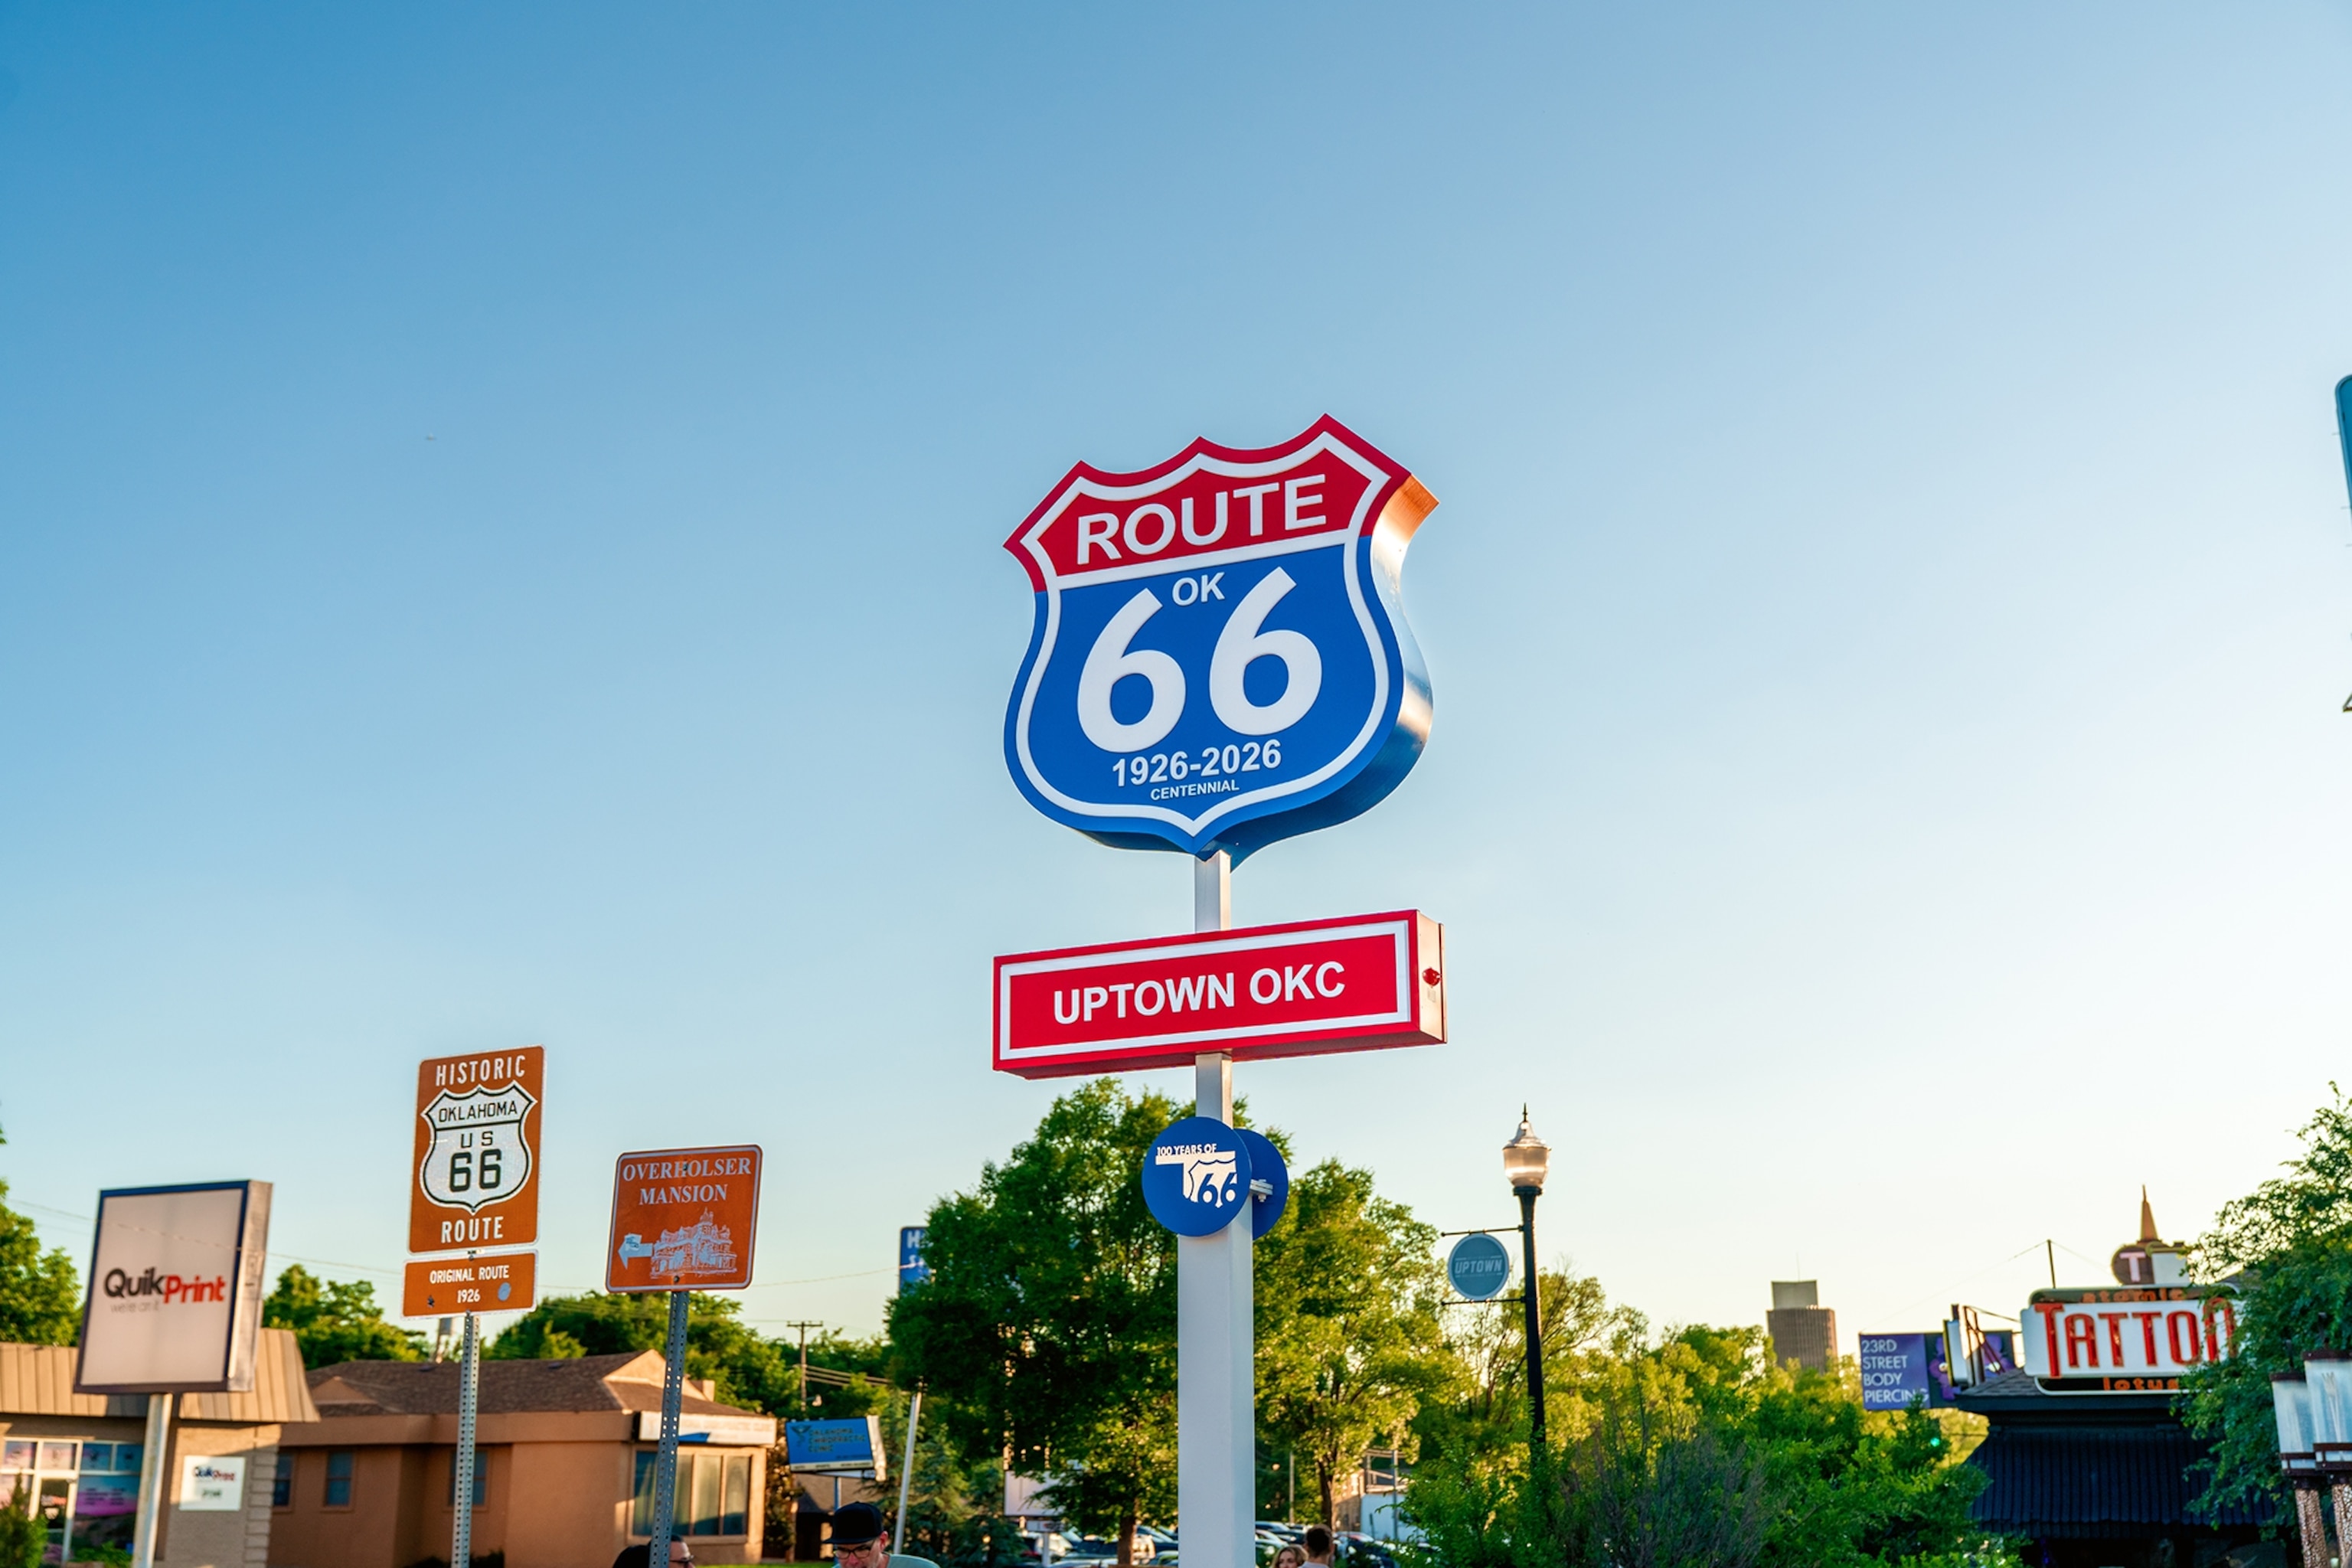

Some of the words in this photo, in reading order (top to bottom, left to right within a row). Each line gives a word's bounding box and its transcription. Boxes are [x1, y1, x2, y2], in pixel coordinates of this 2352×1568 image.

[1076, 474, 1326, 565] ROUTE
[1171, 572, 1225, 606] OK
[1076, 567, 1322, 753] 66
[1112, 739, 1282, 787] 1926-2026
[1150, 779, 1240, 801] CENTENNIAL
[1054, 972, 1234, 1024] UPTOWN
[1250, 961, 1345, 1004] OKC
[435, 1055, 526, 1086] HISTORIC
[439, 1100, 518, 1123] OKLAHOMA
[1157, 1146, 1173, 1156] 100
[1174, 1144, 1203, 1155] YEARS
[1204, 1143, 1217, 1154] OF
[449, 1148, 501, 1192] 66
[622, 1158, 751, 1181] OVERHOLSER
[639, 1184, 728, 1205] MANSION
[1197, 1172, 1237, 1205] 66
[441, 1216, 504, 1243] ROUTE
[430, 1268, 475, 1284] ORIGINAL
[478, 1265, 509, 1281] ROUTE
[1455, 1259, 1503, 1274] UPTOWN
[2119, 1251, 2146, 1282] T
[457, 1289, 481, 1304] 1926
[1861, 1338, 1897, 1354] 23RD
[1863, 1354, 1908, 1370] STREET
[1864, 1372, 1903, 1387] BODY
[2103, 1376, 2179, 1391] lotus
[1864, 1387, 1929, 1403] PIERCING
